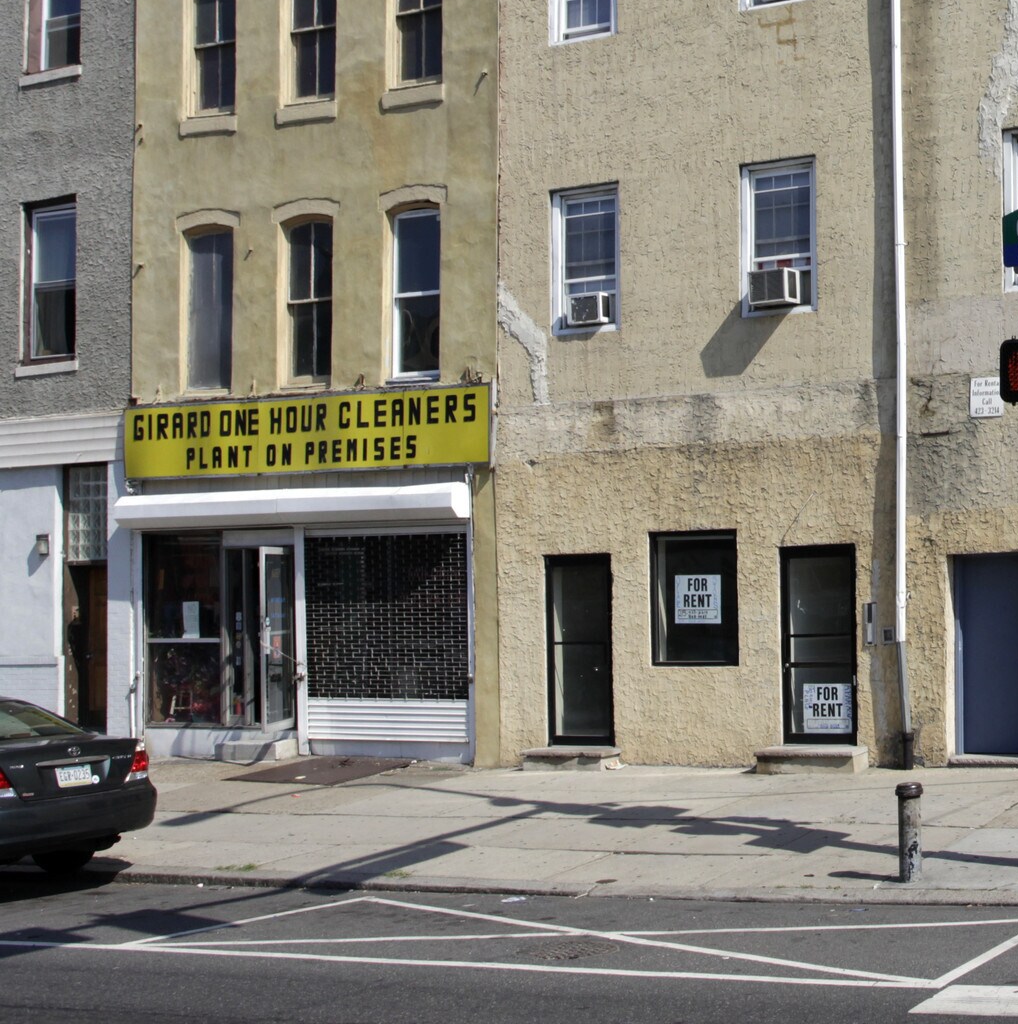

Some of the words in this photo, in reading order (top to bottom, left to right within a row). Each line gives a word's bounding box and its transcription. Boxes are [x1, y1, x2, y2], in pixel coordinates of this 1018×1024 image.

[984, 379, 1000, 387] Renta
[133, 410, 211, 441] GIRARD
[220, 408, 259, 437] ONE
[269, 403, 327, 435] HOUR
[338, 393, 476, 429] CLEANERS
[186, 445, 252, 470] PLANT
[266, 443, 292, 467] ON
[305, 435, 417, 464] PREMISES
[687, 577, 708, 592] FOR
[683, 593, 712, 608] RENT
[817, 686, 838, 701] FOR
[812, 703, 843, 717] RENT
